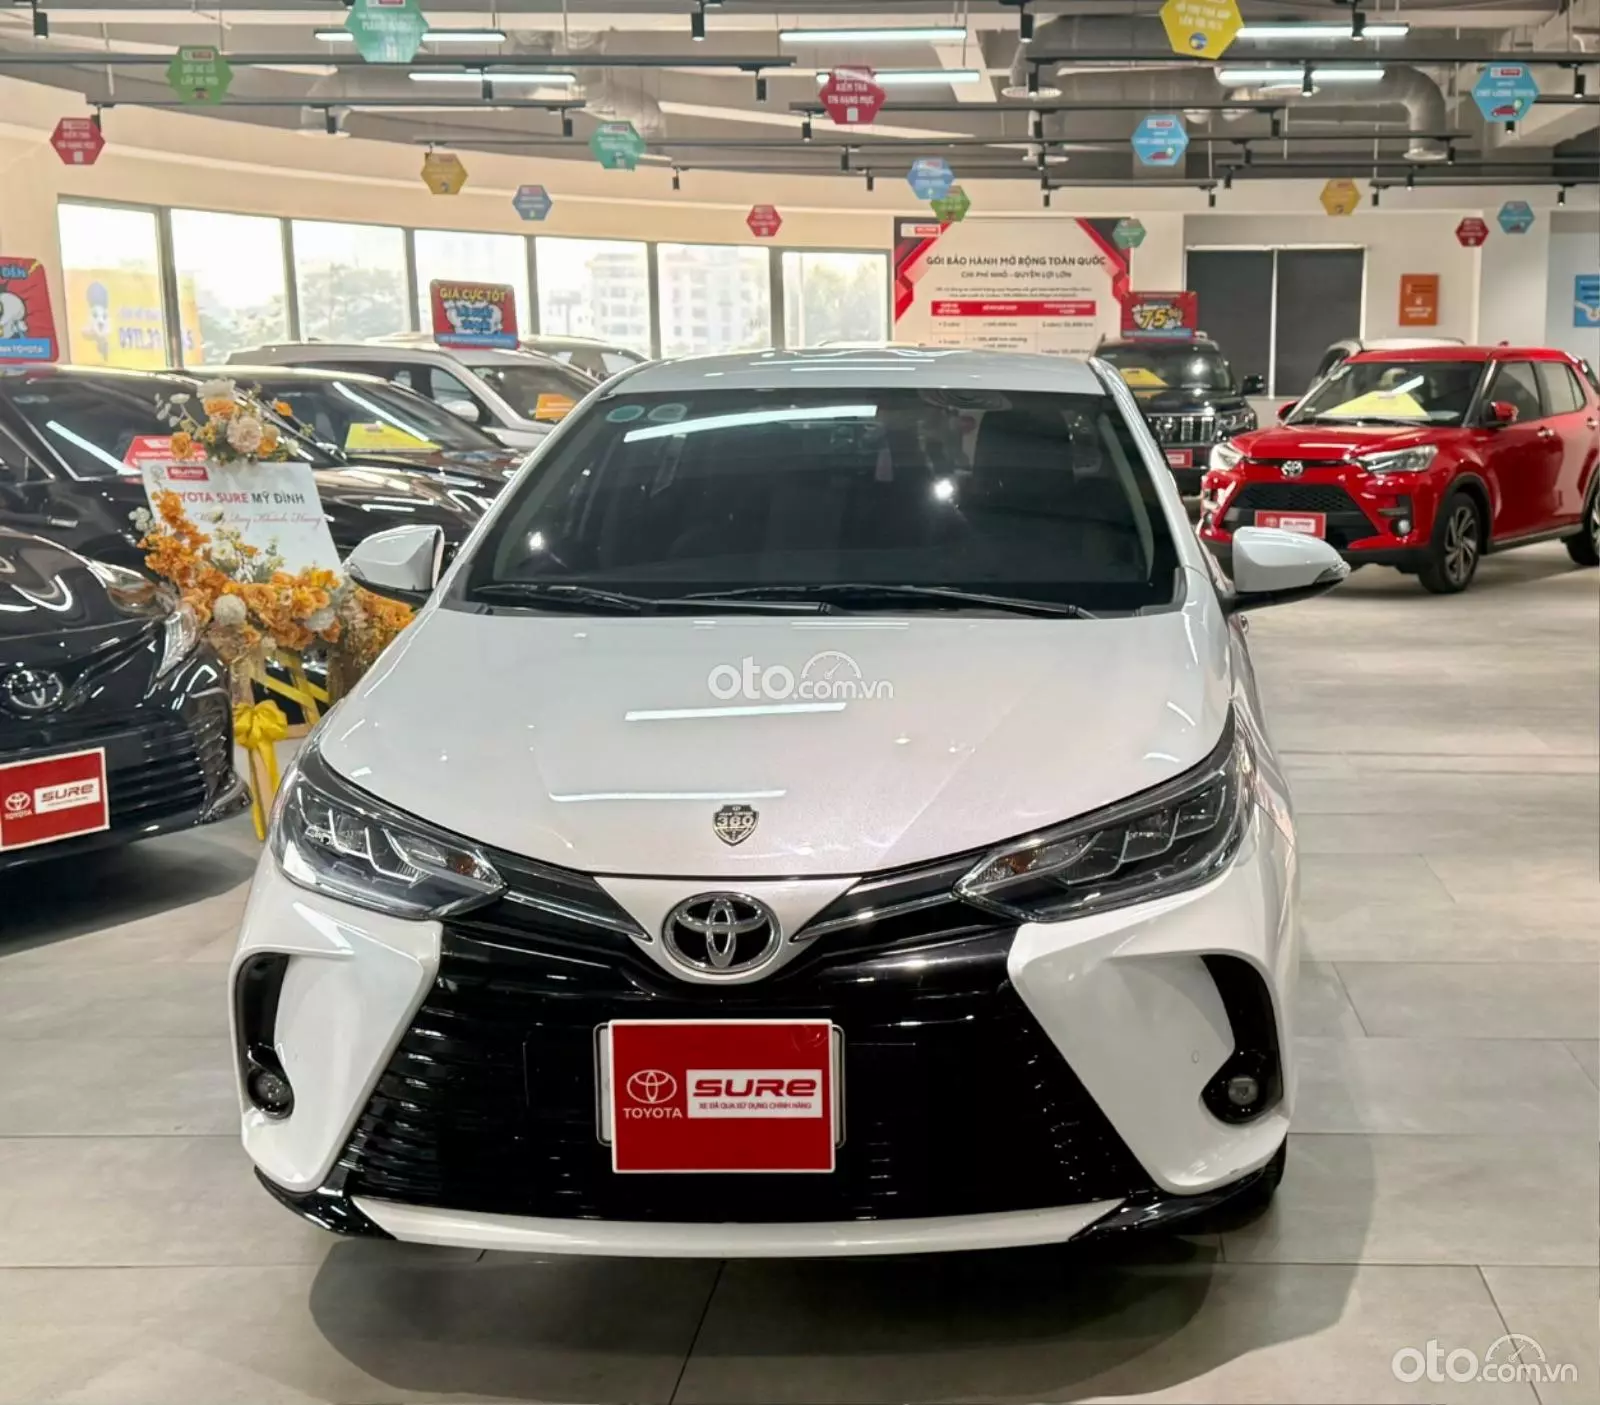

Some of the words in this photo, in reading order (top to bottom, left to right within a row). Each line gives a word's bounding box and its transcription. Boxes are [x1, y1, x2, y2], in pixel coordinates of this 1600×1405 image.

[216, 492, 249, 504] SURE
[41, 783, 94, 803] SURE
[693, 1079, 817, 1097] SURE
[623, 1107, 683, 1119] TOYOTA
